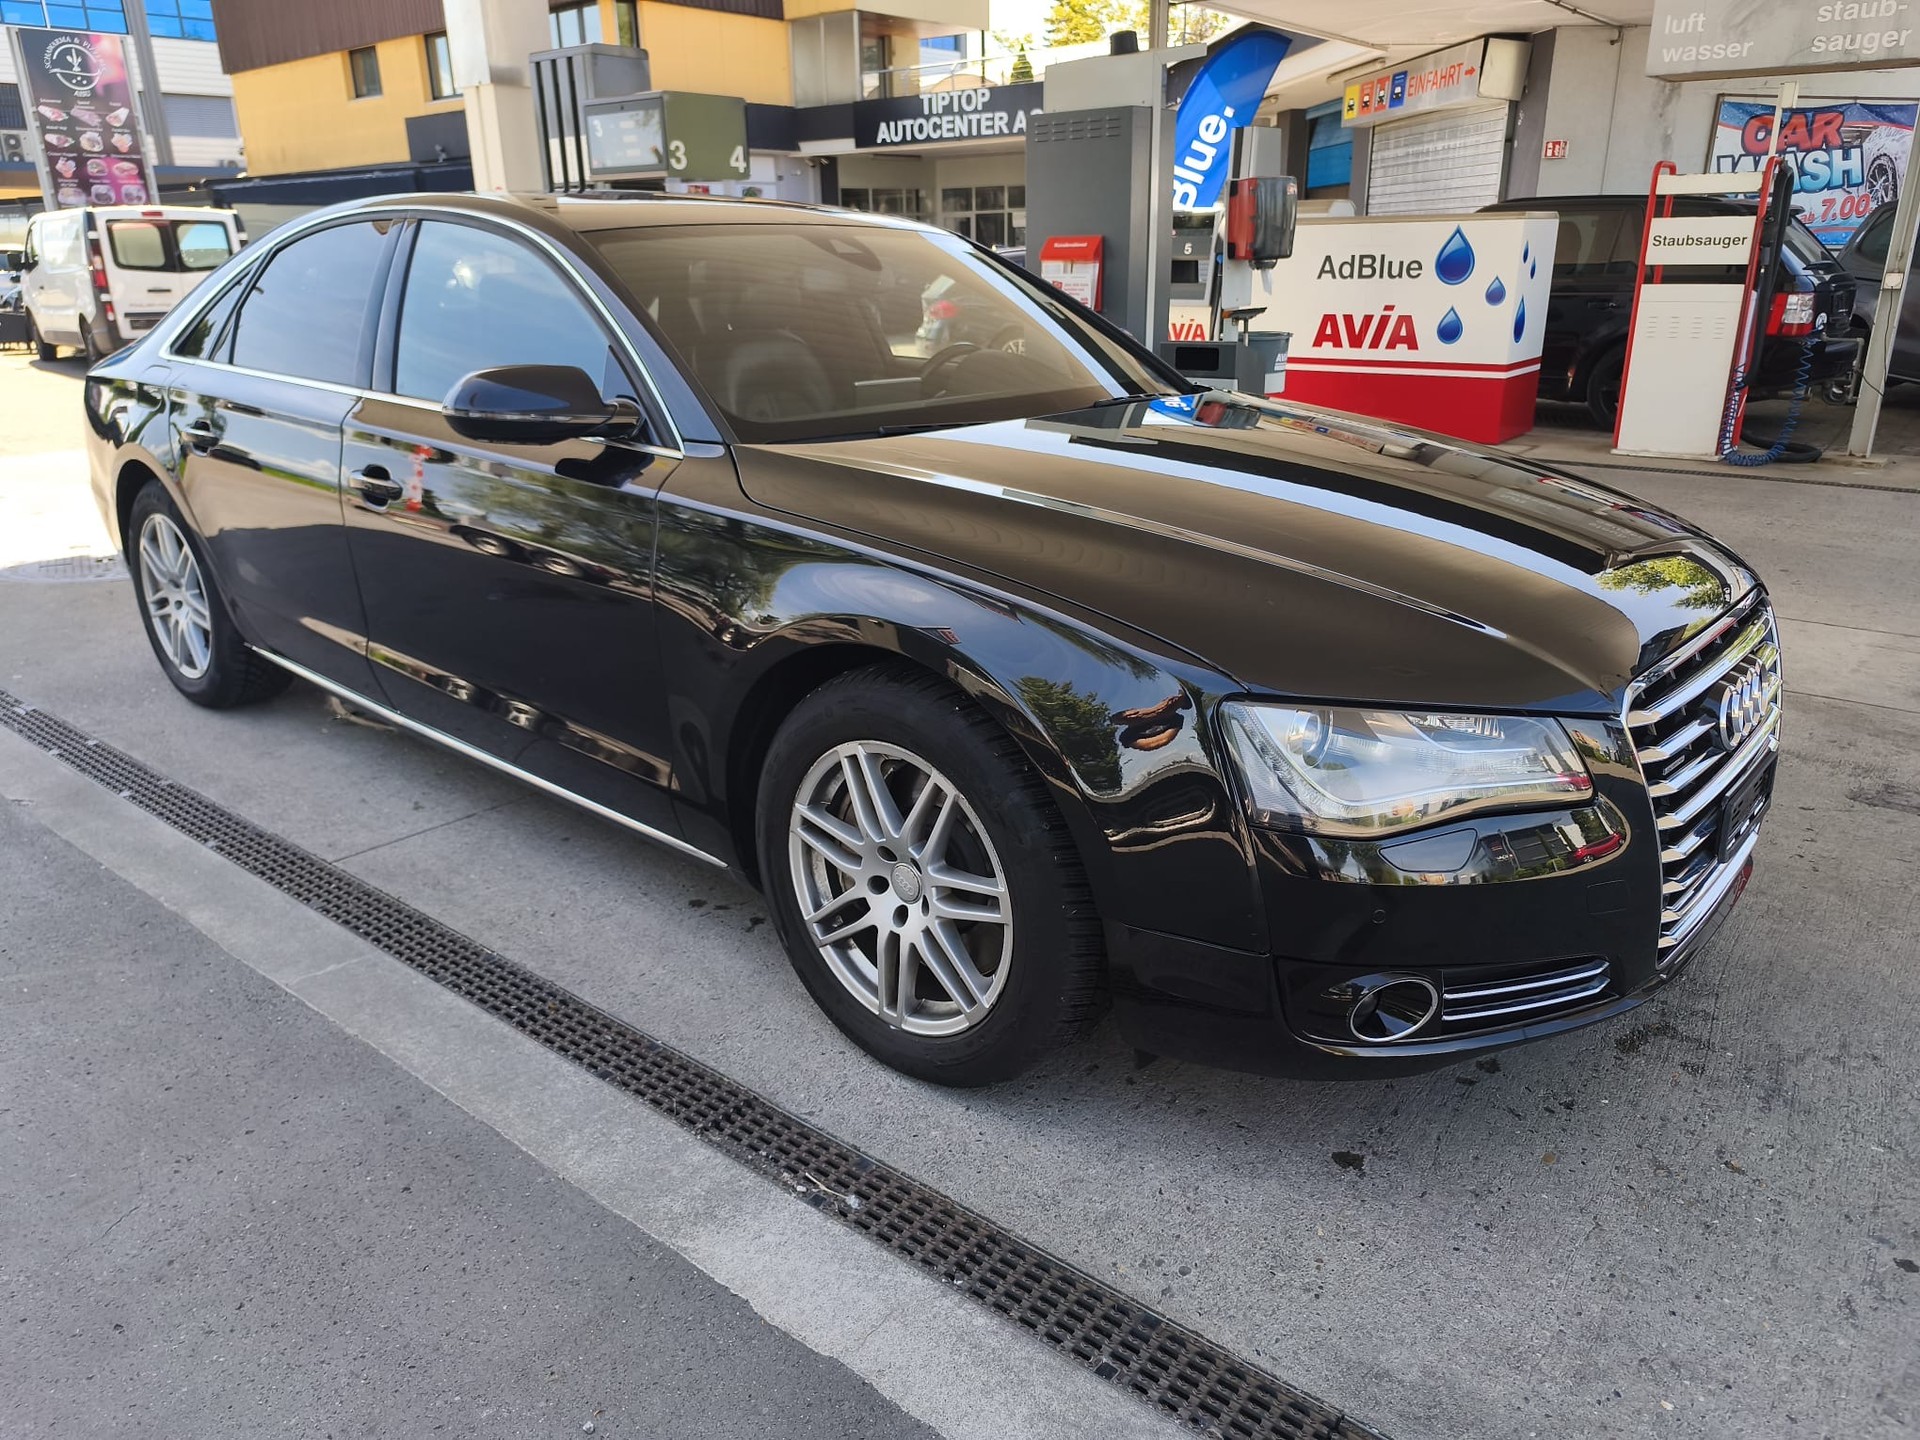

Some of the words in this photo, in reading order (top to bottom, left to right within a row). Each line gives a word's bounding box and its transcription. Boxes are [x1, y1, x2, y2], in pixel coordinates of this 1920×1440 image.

[1664, 13, 1706, 35] luft
[1817, 0, 1908, 22] staub-
[1662, 39, 1754, 63] wasser
[1811, 28, 1913, 55] sauger
[1407, 62, 1464, 97] EINFAHRT
[919, 88, 991, 115] TIPTOP
[876, 111, 1010, 143] AUTOCENTER
[1741, 111, 1845, 154] CAR
[669, 140, 688, 171] 3
[729, 145, 748, 173] 4
[1820, 193, 1871, 222] 7.00
[1183, 243, 1193, 255] 5
[1652, 234, 1748, 249] Staubsauger
[1317, 254, 1423, 280] AdBlue
[1312, 304, 1420, 351] AVIA
